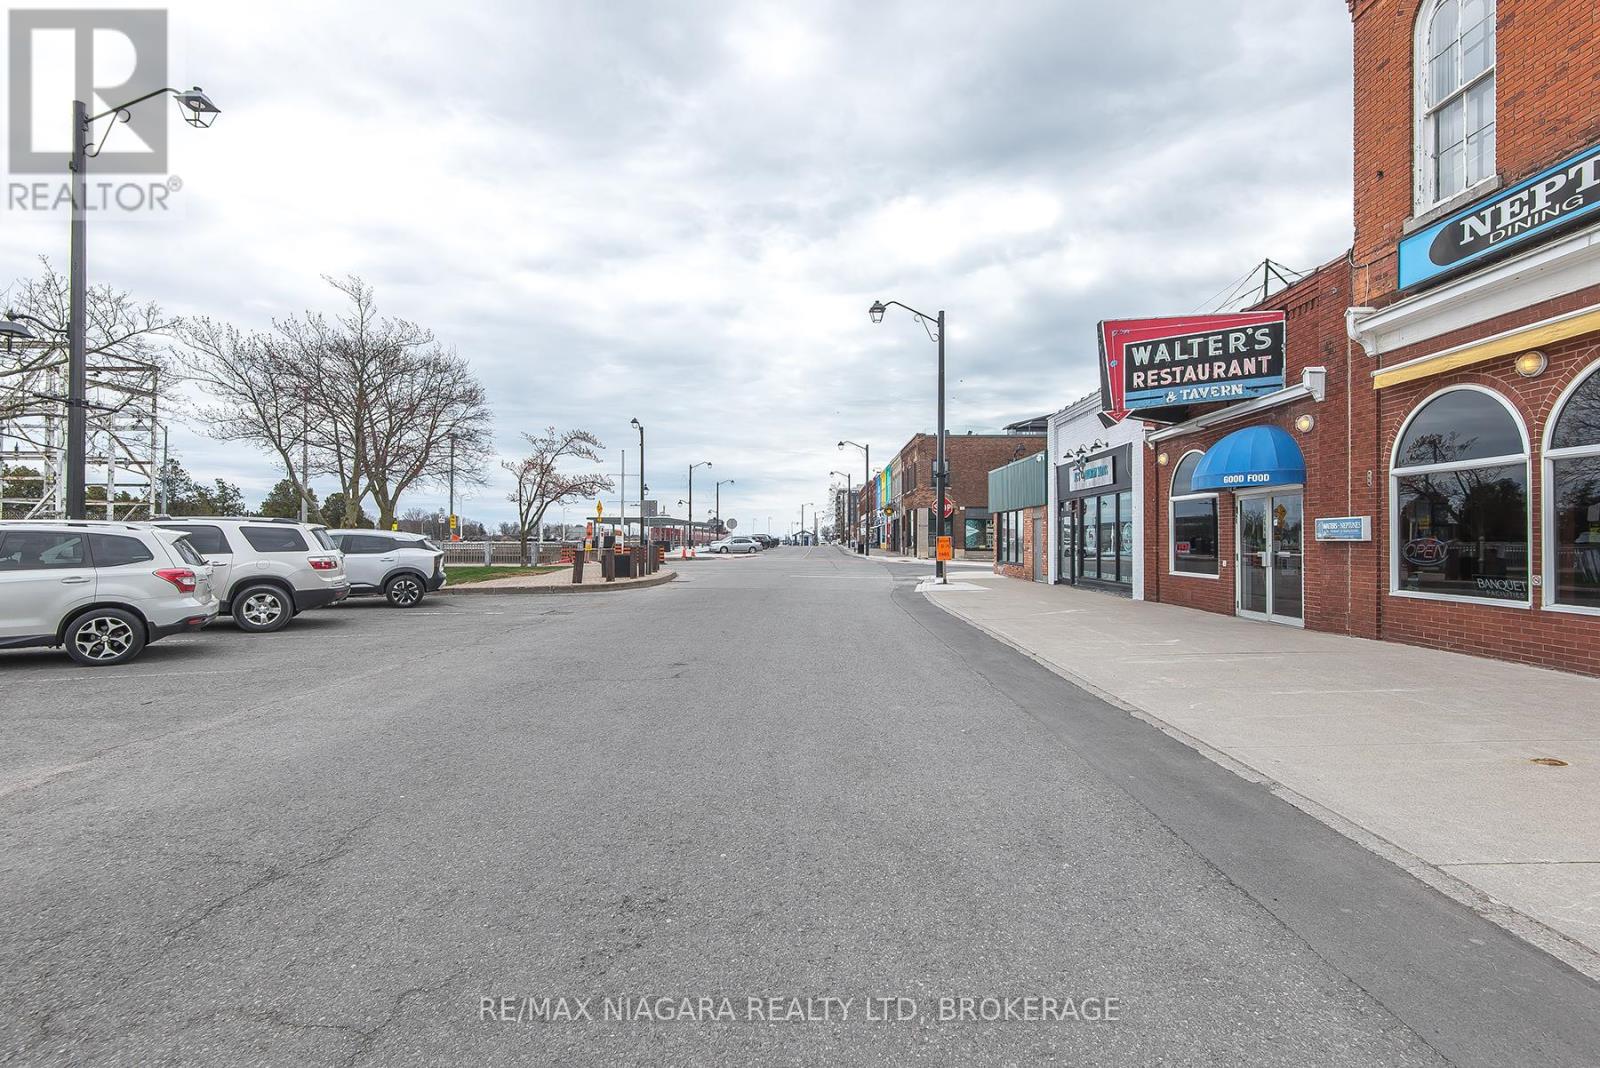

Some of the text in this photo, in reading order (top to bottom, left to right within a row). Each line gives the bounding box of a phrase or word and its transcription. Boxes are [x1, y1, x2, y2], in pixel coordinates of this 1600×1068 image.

[1489, 194, 1583, 244] DINING
[1131, 327, 1272, 366] WALTER'S
[1132, 355, 1272, 389] RESTAURANT
[1166, 383, 1244, 403] & TAVERN
[1223, 473, 1270, 484] GOOD FOOD
[1403, 543, 1449, 560] OPEN
[1477, 578, 1527, 593] BANQUET
